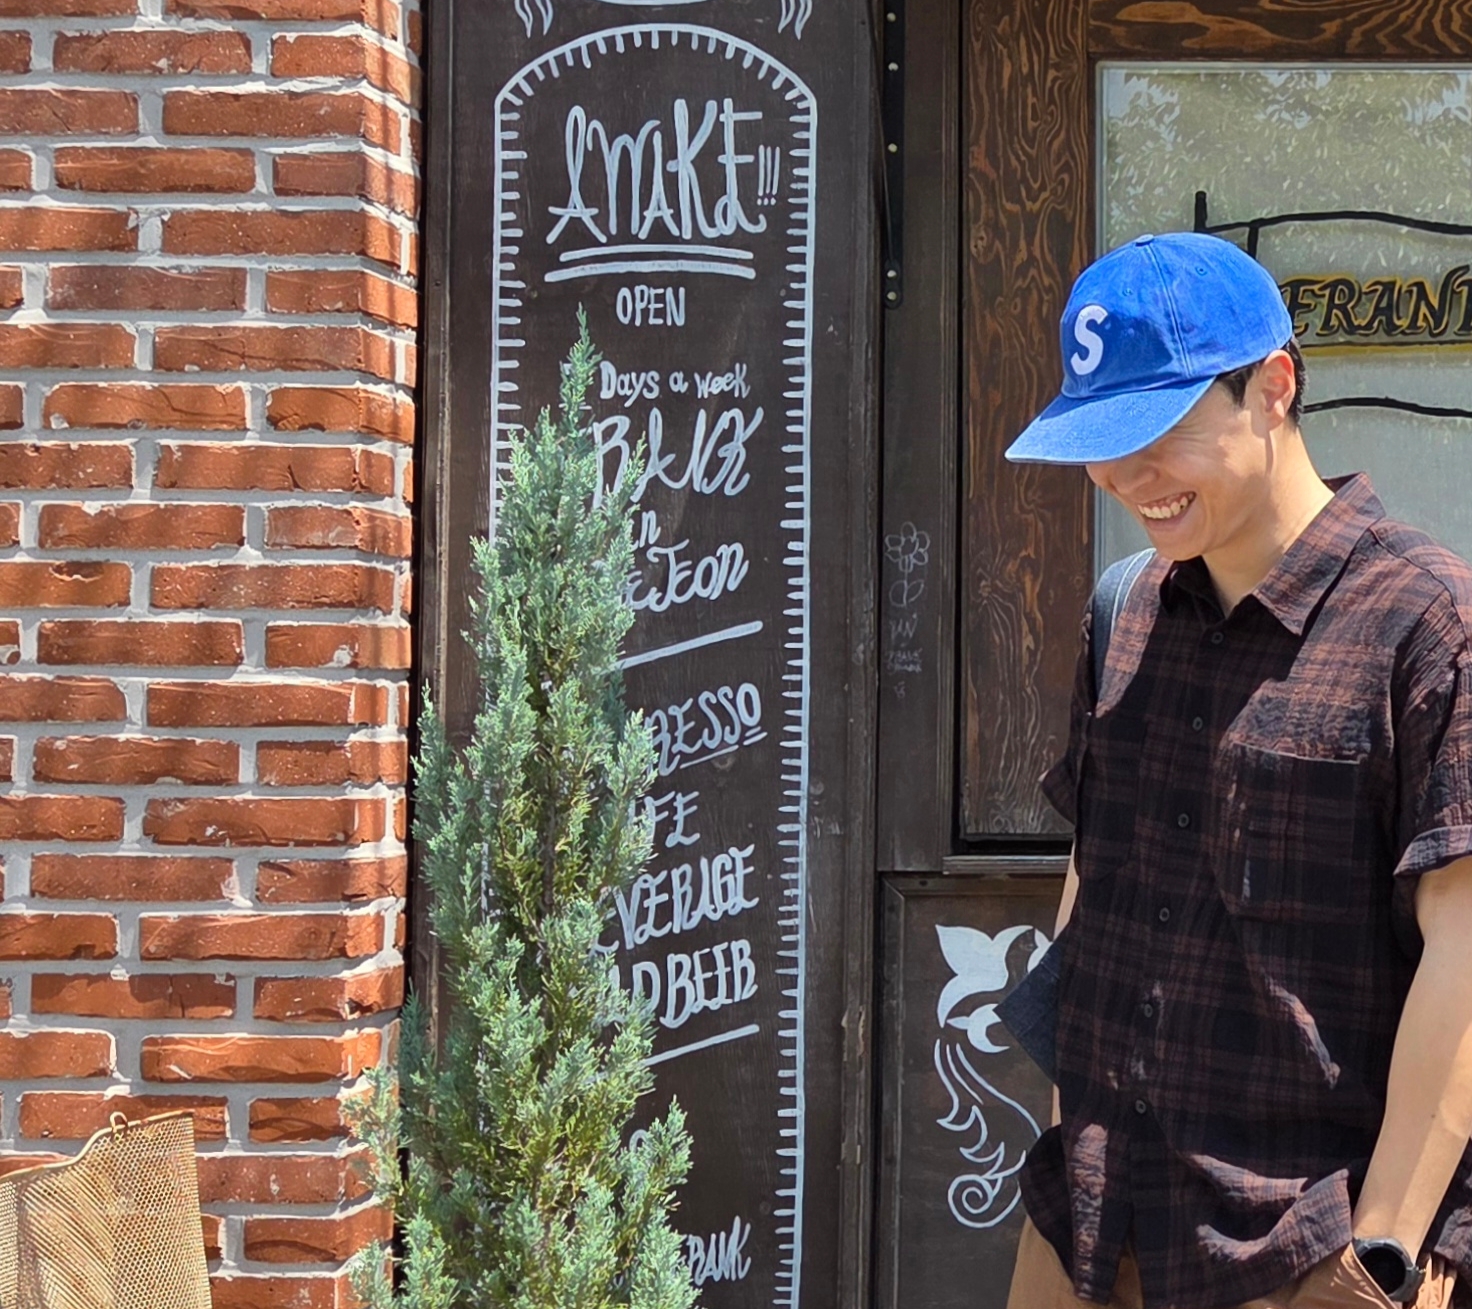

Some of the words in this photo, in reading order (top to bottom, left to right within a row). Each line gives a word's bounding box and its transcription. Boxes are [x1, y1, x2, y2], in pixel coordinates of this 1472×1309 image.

[617, 285, 686, 327] OPEN
[1070, 304, 1109, 376] S
[600, 360, 660, 408] Days
[669, 371, 689, 393] a
[580, 406, 764, 510] RANK
[645, 682, 762, 776] RESSO
[684, 1215, 752, 1286] RANK
